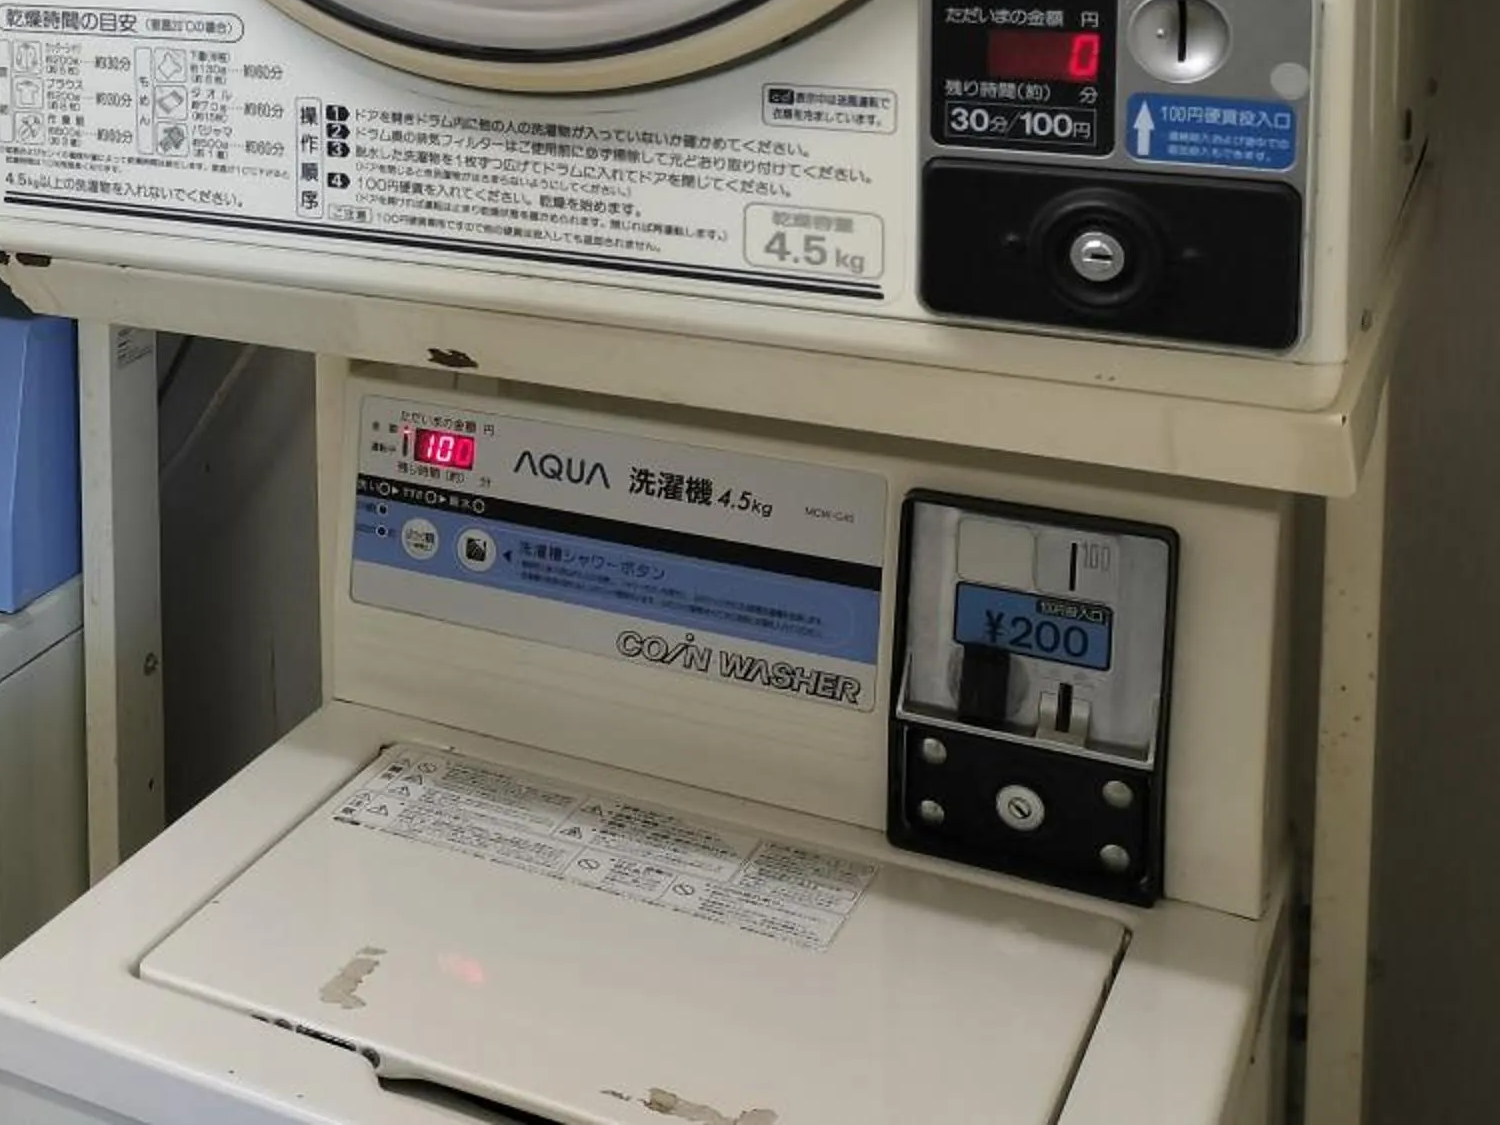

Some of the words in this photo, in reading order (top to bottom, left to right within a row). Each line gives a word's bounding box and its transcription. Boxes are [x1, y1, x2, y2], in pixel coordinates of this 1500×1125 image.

[6, 9, 137, 33] 乾燥時間の目安
[945, 7, 1064, 27] ただいまの金額
[1081, 11, 1099, 27] 円
[1069, 33, 1100, 77] 0
[1079, 87, 1098, 104] 分
[514, 451, 610, 489] AQUA
[628, 466, 713, 507] 洗濯機
[718, 489, 773, 517] 4.5kg
[519, 541, 665, 581] 洗濯槽シャワーボタン
[984, 609, 1089, 659] ¥200
[616, 632, 712, 672] COIN
[719, 650, 860, 704] WASHER
